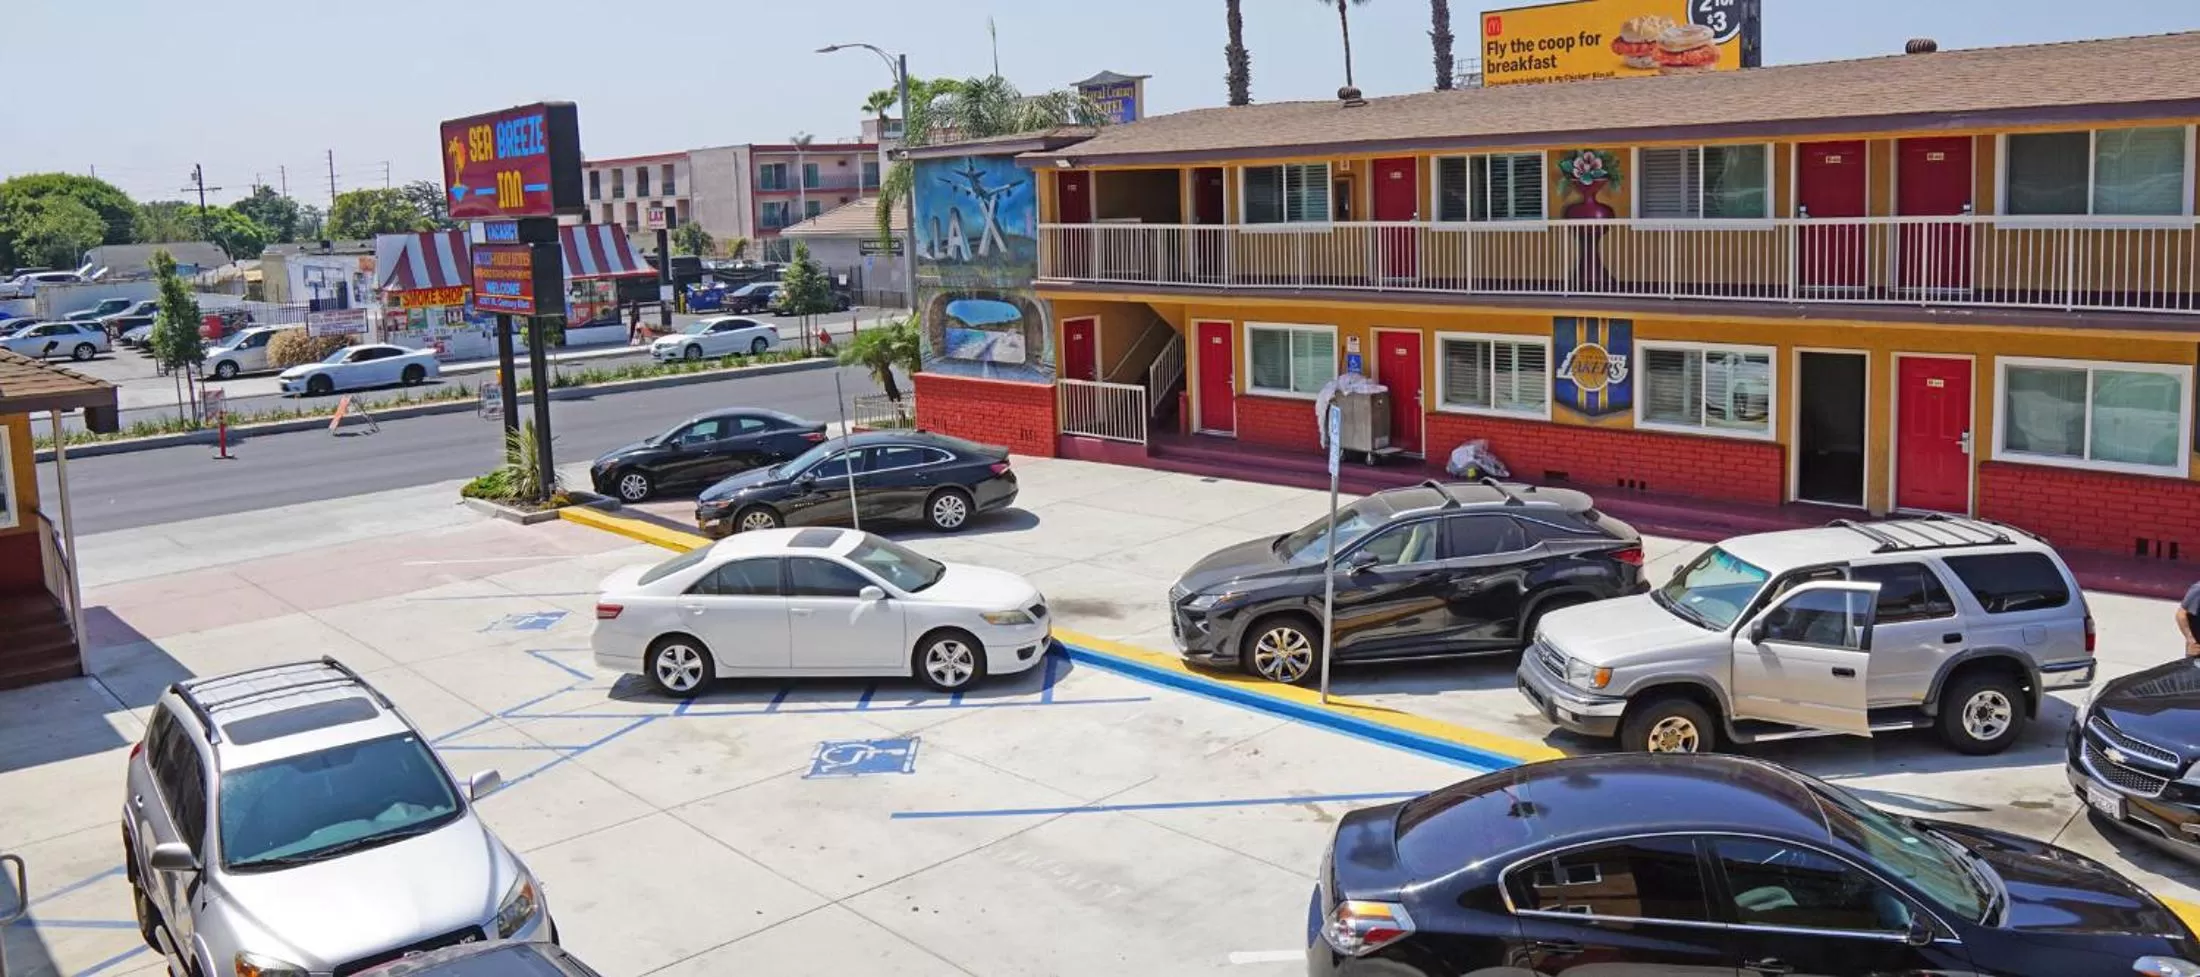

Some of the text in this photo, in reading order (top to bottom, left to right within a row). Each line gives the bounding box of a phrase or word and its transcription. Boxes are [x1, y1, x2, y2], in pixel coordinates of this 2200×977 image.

[1707, 11, 1727, 32] $3
[1486, 31, 1602, 58] Fly the coop for
[1486, 54, 1558, 74] breakfast
[468, 115, 545, 162] SEA BREEZE
[931, 197, 1009, 262] LAX
[402, 287, 464, 306] SMOKE SHOP
[484, 280, 521, 295] WELCOME
